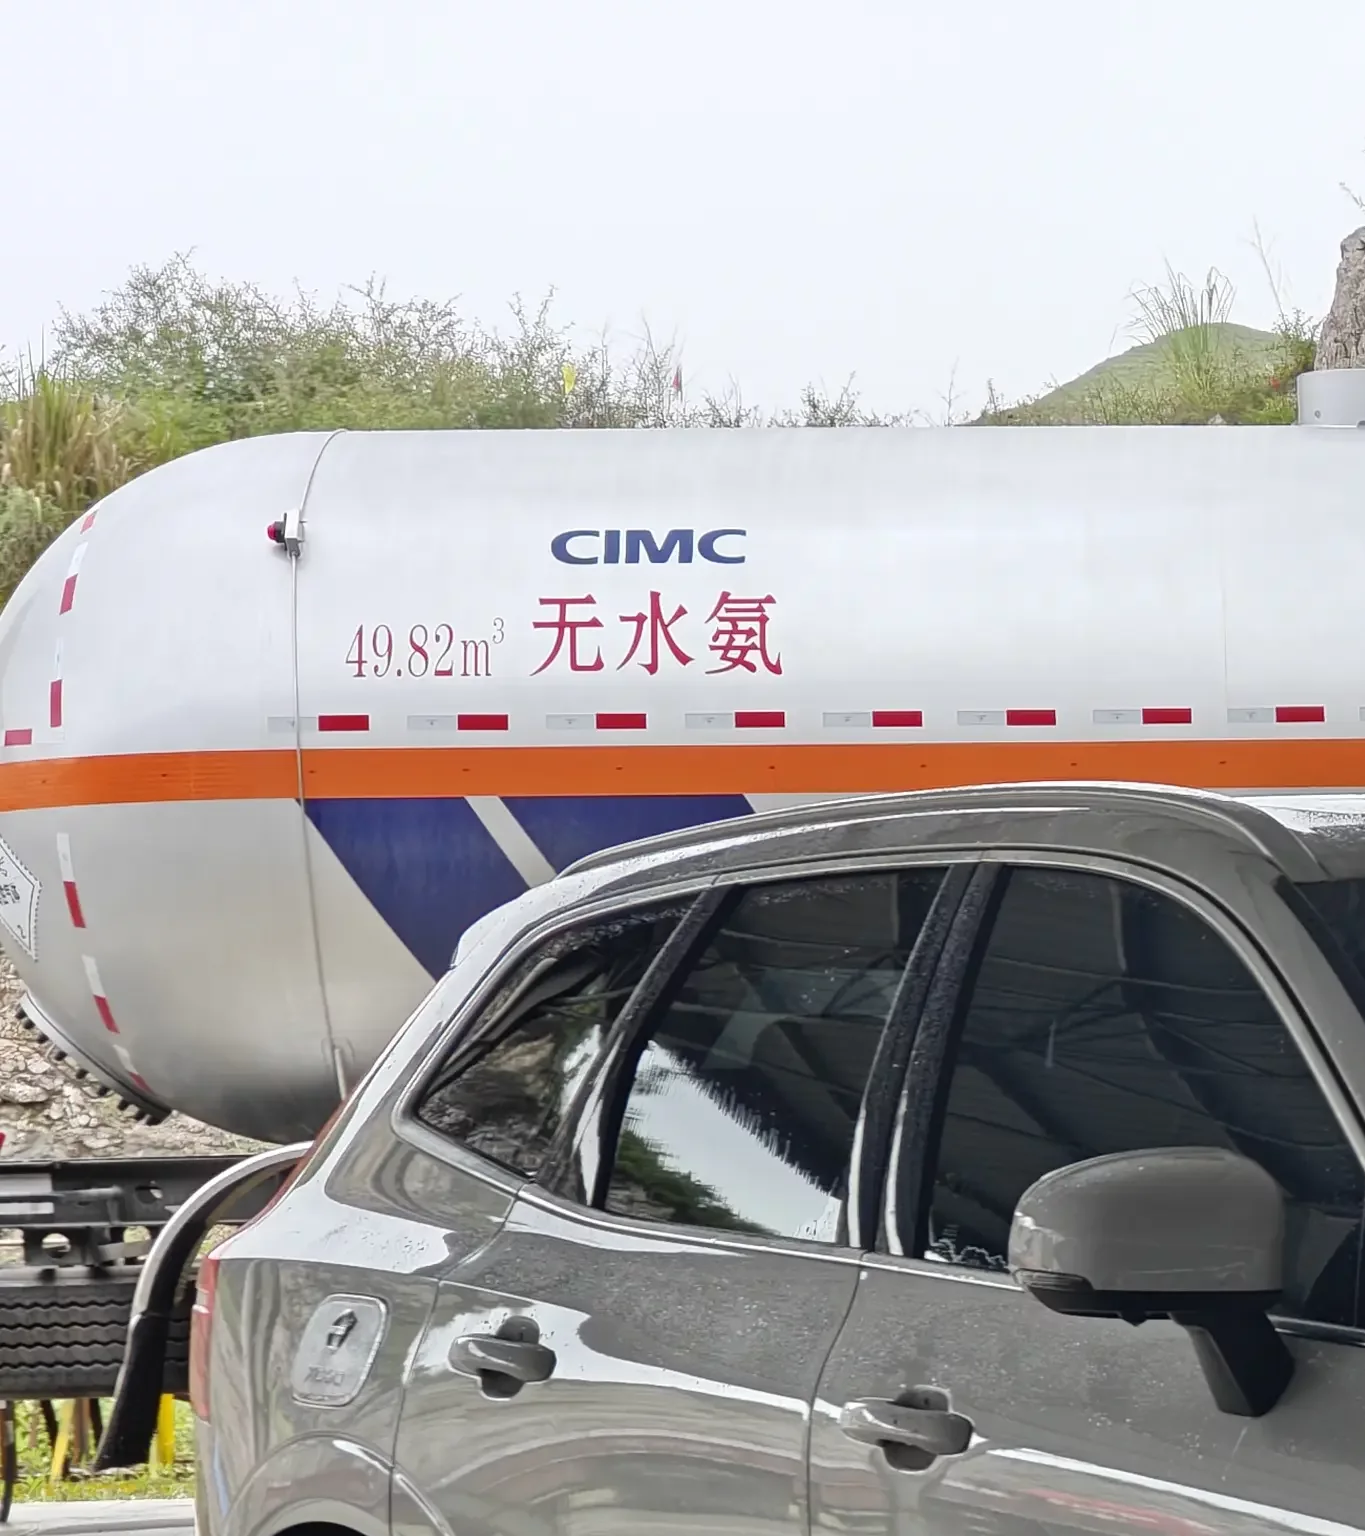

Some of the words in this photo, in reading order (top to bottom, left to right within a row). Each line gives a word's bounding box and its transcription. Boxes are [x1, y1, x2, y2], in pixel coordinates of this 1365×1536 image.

[551, 529, 747, 564] CIMC
[529, 590, 783, 676] 无水氨
